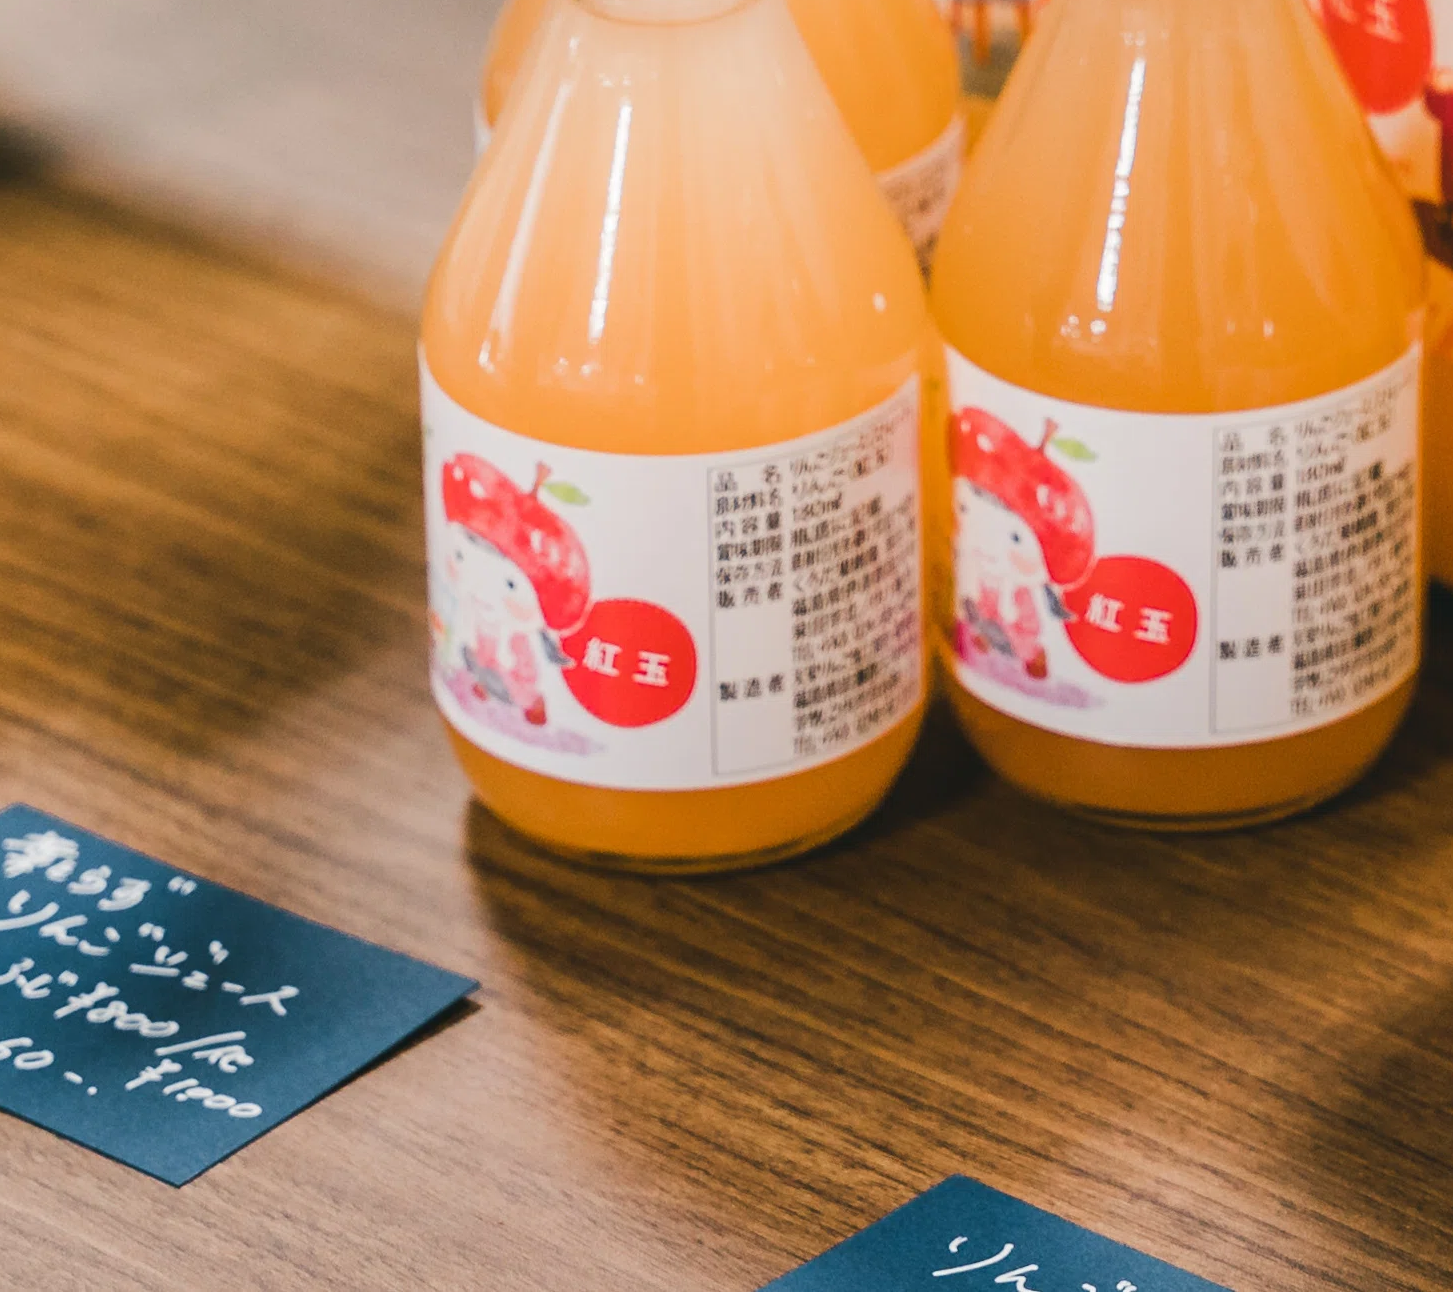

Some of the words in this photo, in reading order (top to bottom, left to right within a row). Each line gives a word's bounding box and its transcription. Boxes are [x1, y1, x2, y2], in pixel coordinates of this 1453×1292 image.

[1086, 594, 1173, 646] 紅玉
[582, 638, 672, 688] 紅玉
[933, 1235, 1139, 1292] りん
